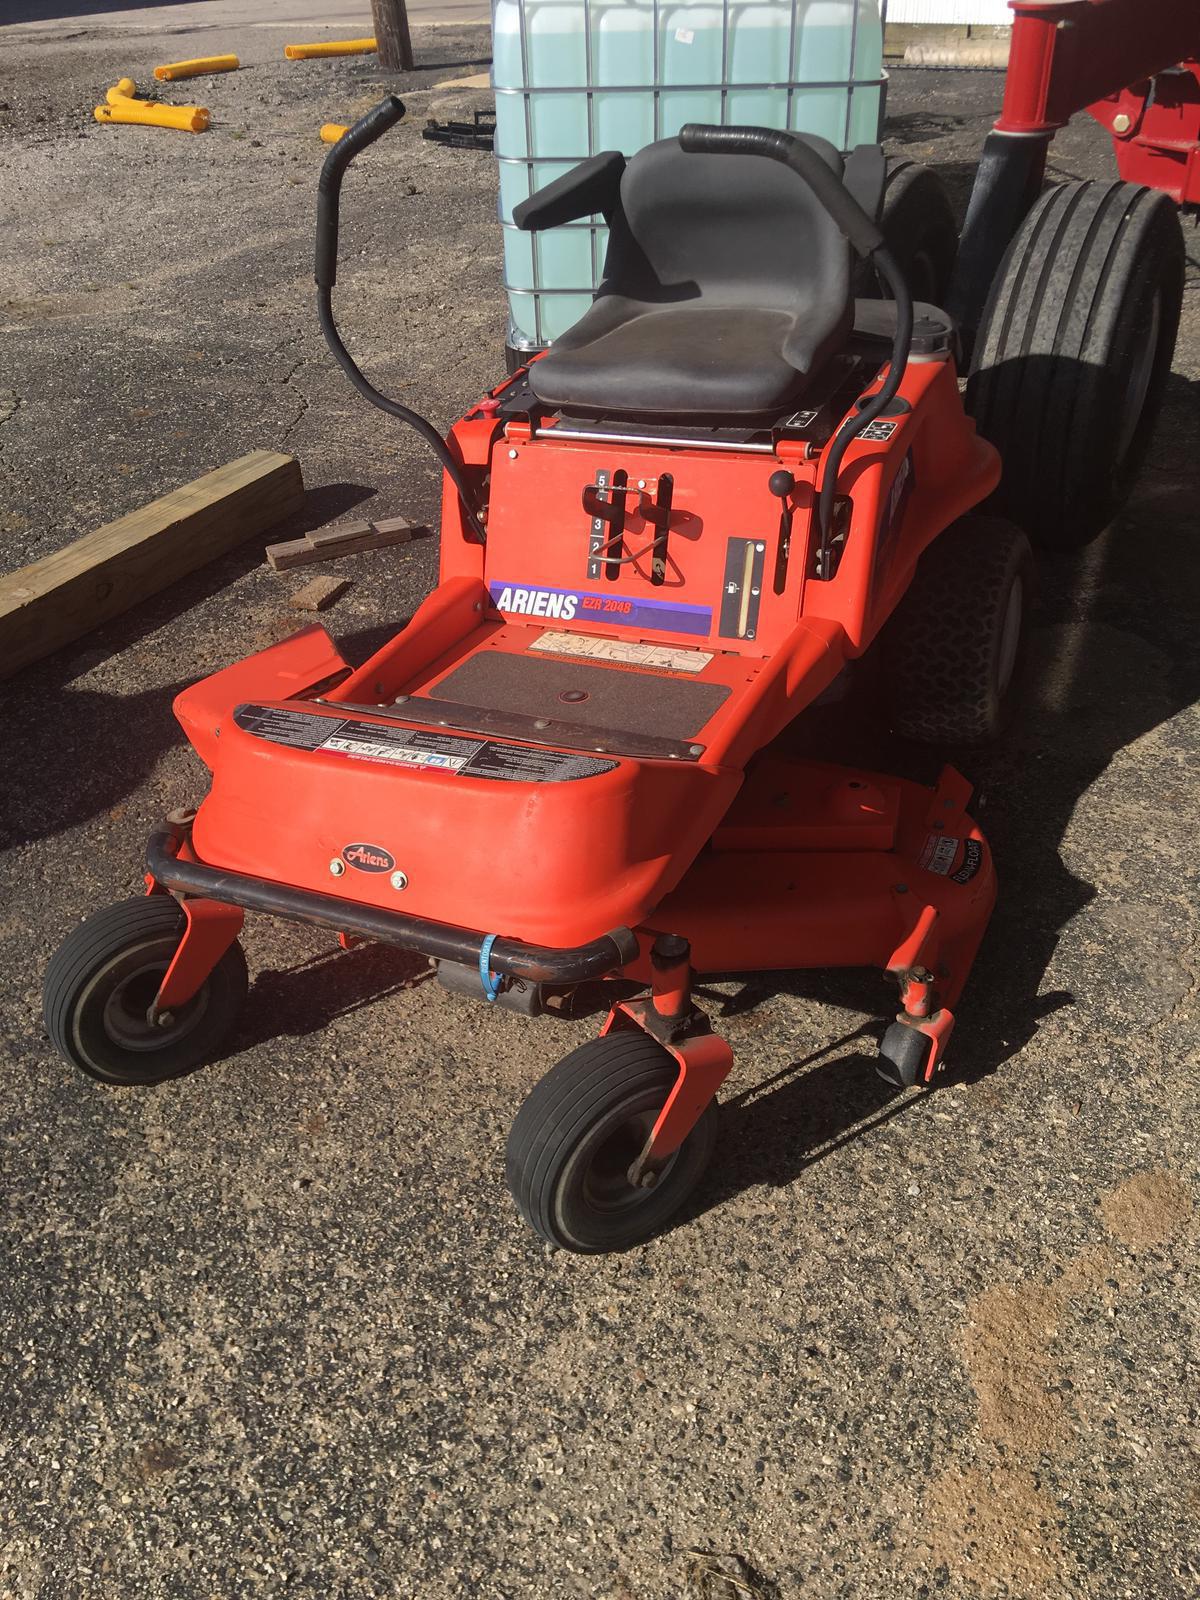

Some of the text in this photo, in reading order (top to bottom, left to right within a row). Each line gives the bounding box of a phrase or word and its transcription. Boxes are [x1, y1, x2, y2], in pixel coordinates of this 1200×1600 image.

[598, 475, 606, 486] 5
[594, 518, 602, 530] 3
[592, 541, 600, 552] 2
[591, 563, 597, 574] 1
[496, 587, 632, 620] ARIENS EZR 2048
[346, 846, 389, 868] Ariens
